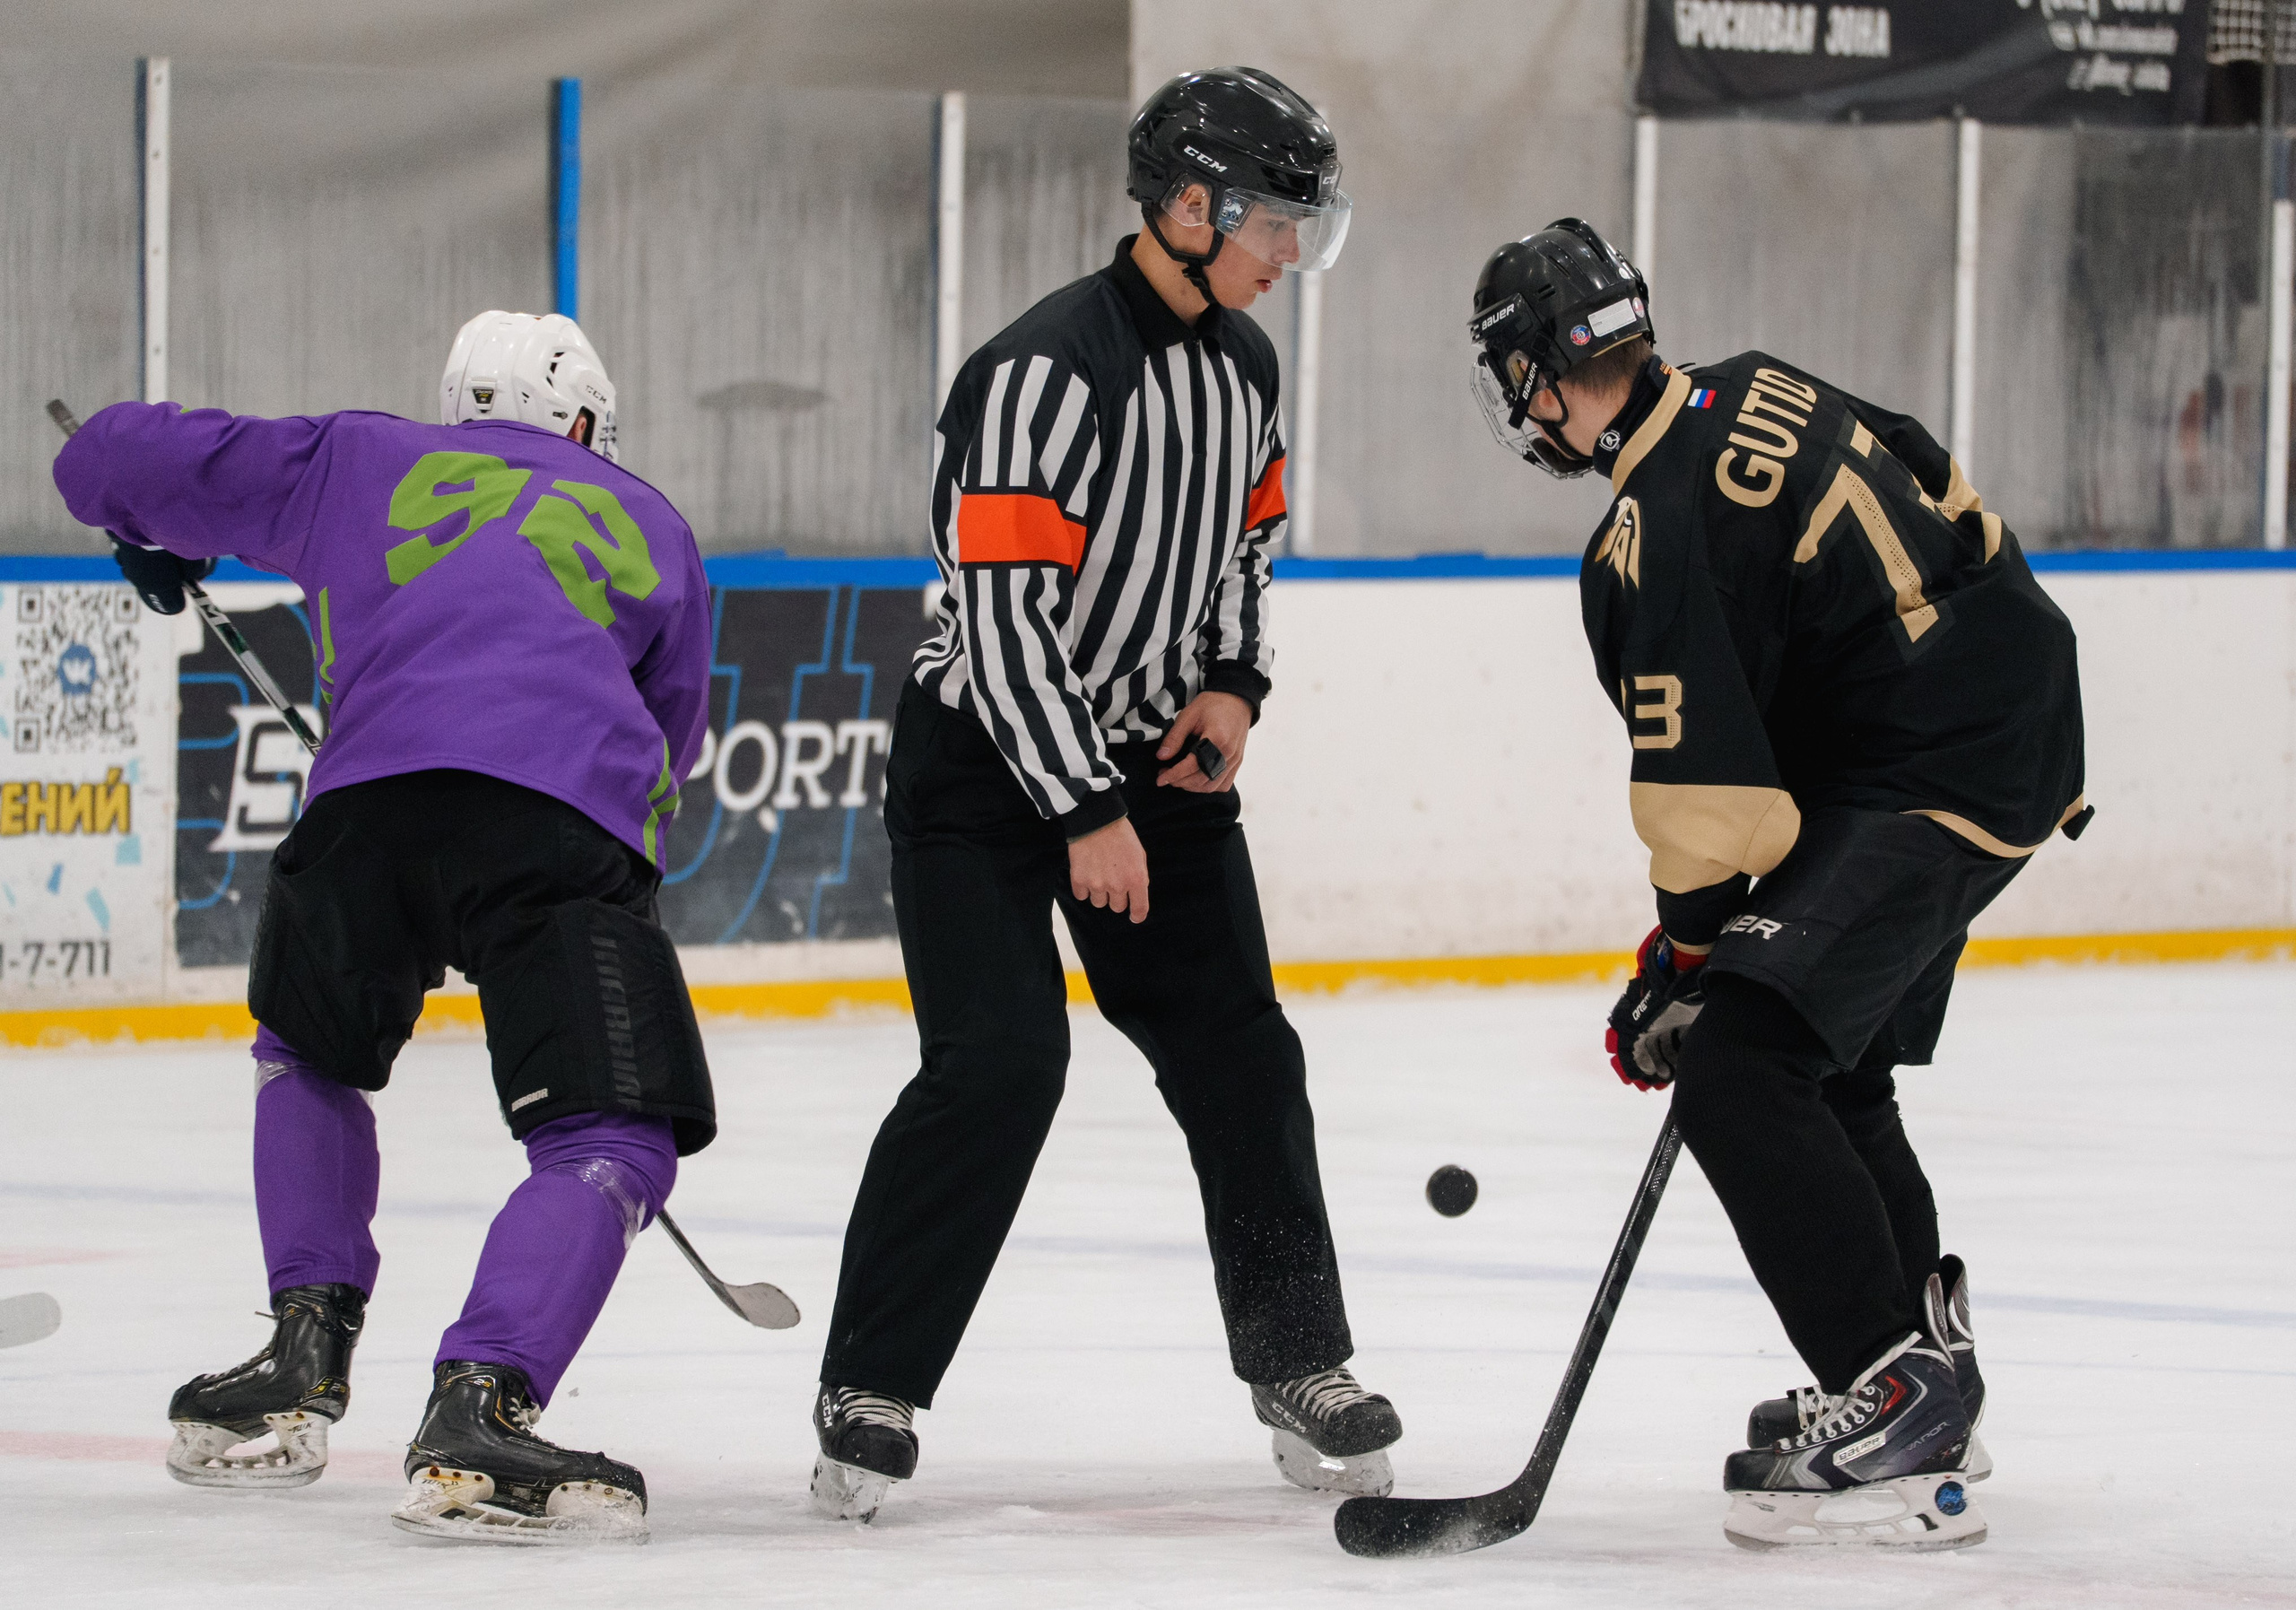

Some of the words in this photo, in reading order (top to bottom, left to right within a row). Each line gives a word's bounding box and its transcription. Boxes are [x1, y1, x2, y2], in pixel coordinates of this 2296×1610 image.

[1183, 144, 1228, 173] CCM
[1715, 368, 1818, 508] GUTID
[1620, 674, 1683, 749] 3
[822, 1393, 833, 1428] CCM
[1272, 1401, 1307, 1433] CCM
